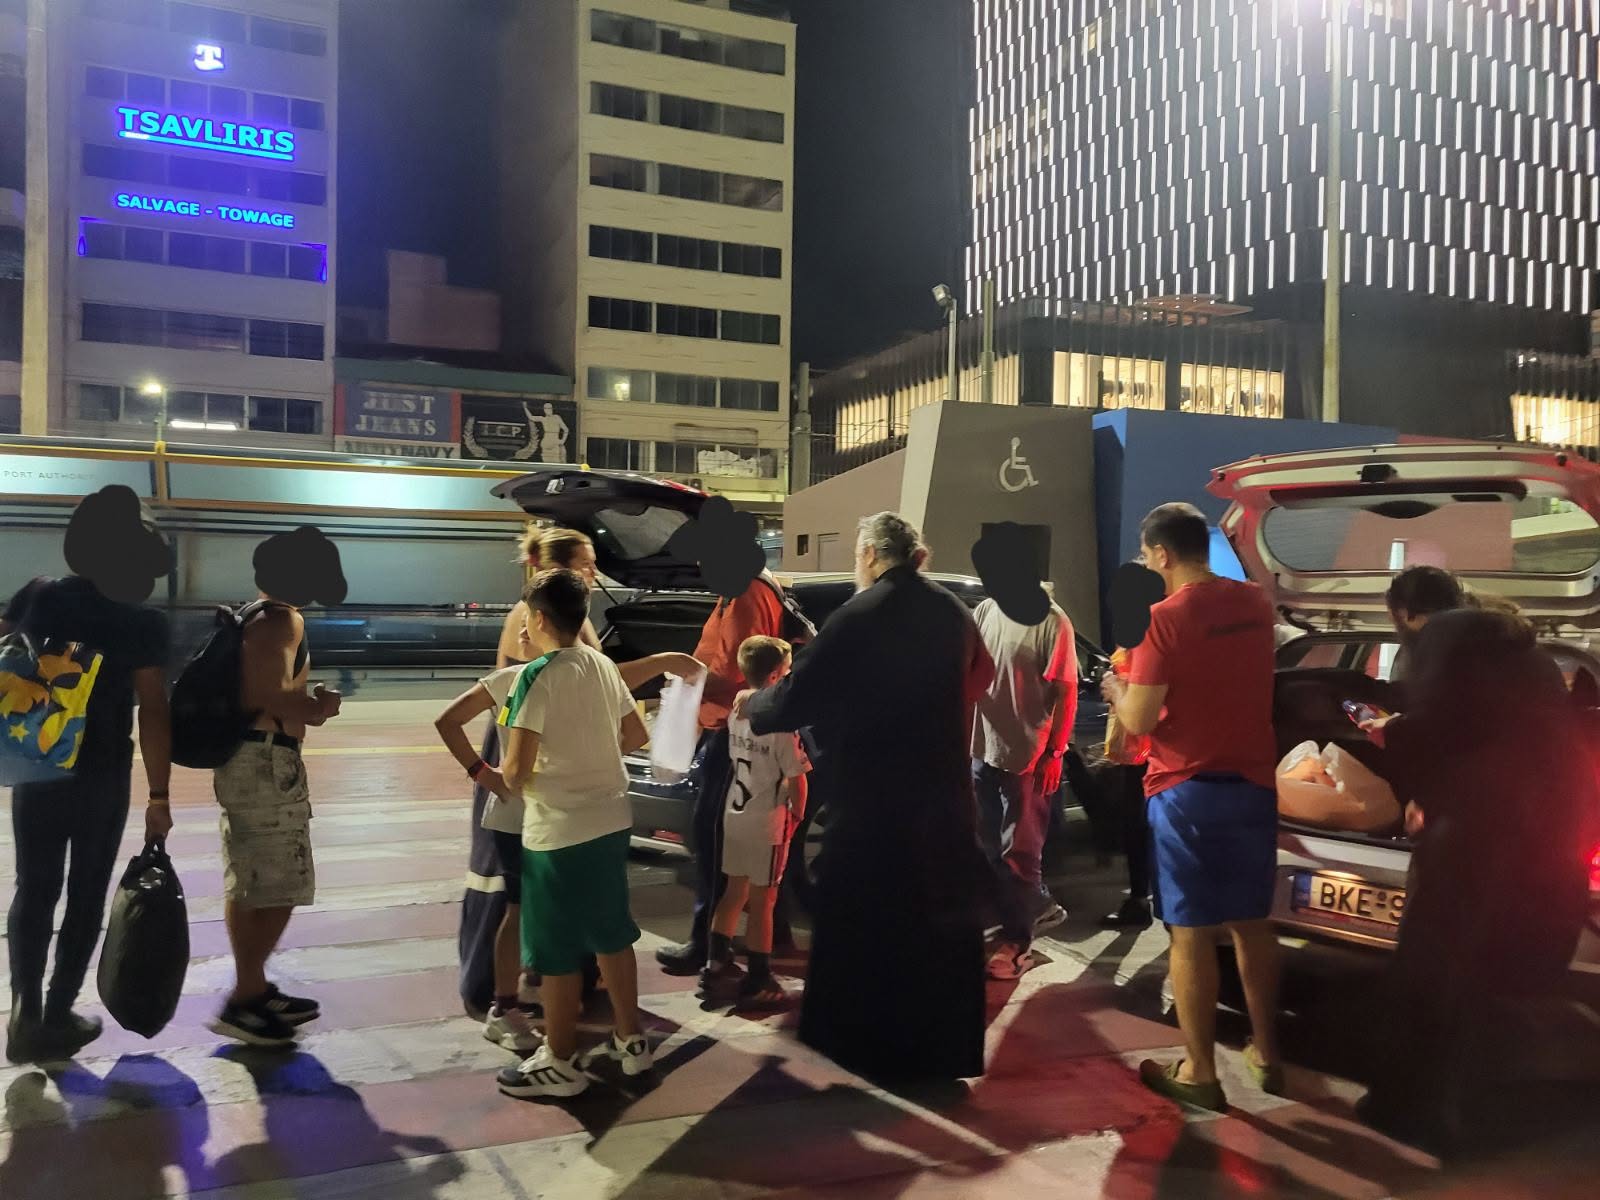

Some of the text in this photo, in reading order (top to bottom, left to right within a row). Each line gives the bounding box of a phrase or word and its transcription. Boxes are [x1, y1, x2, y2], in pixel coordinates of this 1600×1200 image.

[118, 107, 295, 153] TSAVLIRIS
[117, 193, 200, 216] SALVAGE
[218, 206, 295, 228] TOWAGE
[364, 392, 434, 414] JUST
[356, 415, 437, 436] JEANS
[4, 470, 33, 478] PORT
[732, 758, 752, 811] 5
